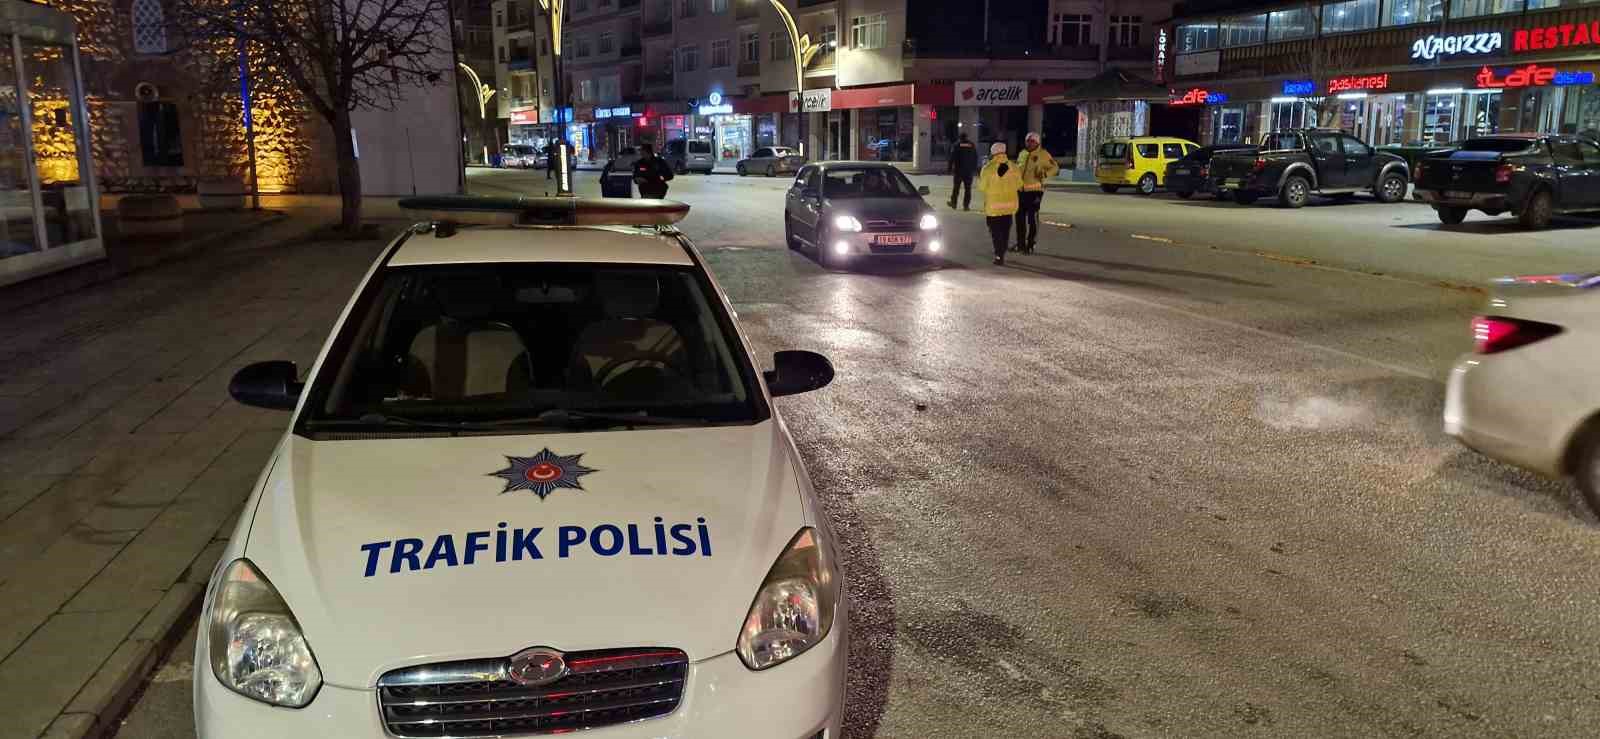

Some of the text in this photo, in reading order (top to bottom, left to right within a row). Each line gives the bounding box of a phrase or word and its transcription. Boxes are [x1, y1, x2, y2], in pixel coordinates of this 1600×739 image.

[1411, 31, 1503, 59] NAGIZZA
[799, 94, 826, 108] rçelik
[975, 85, 1024, 105] arçelik
[360, 516, 713, 578] TRAFİK POLİSİ
